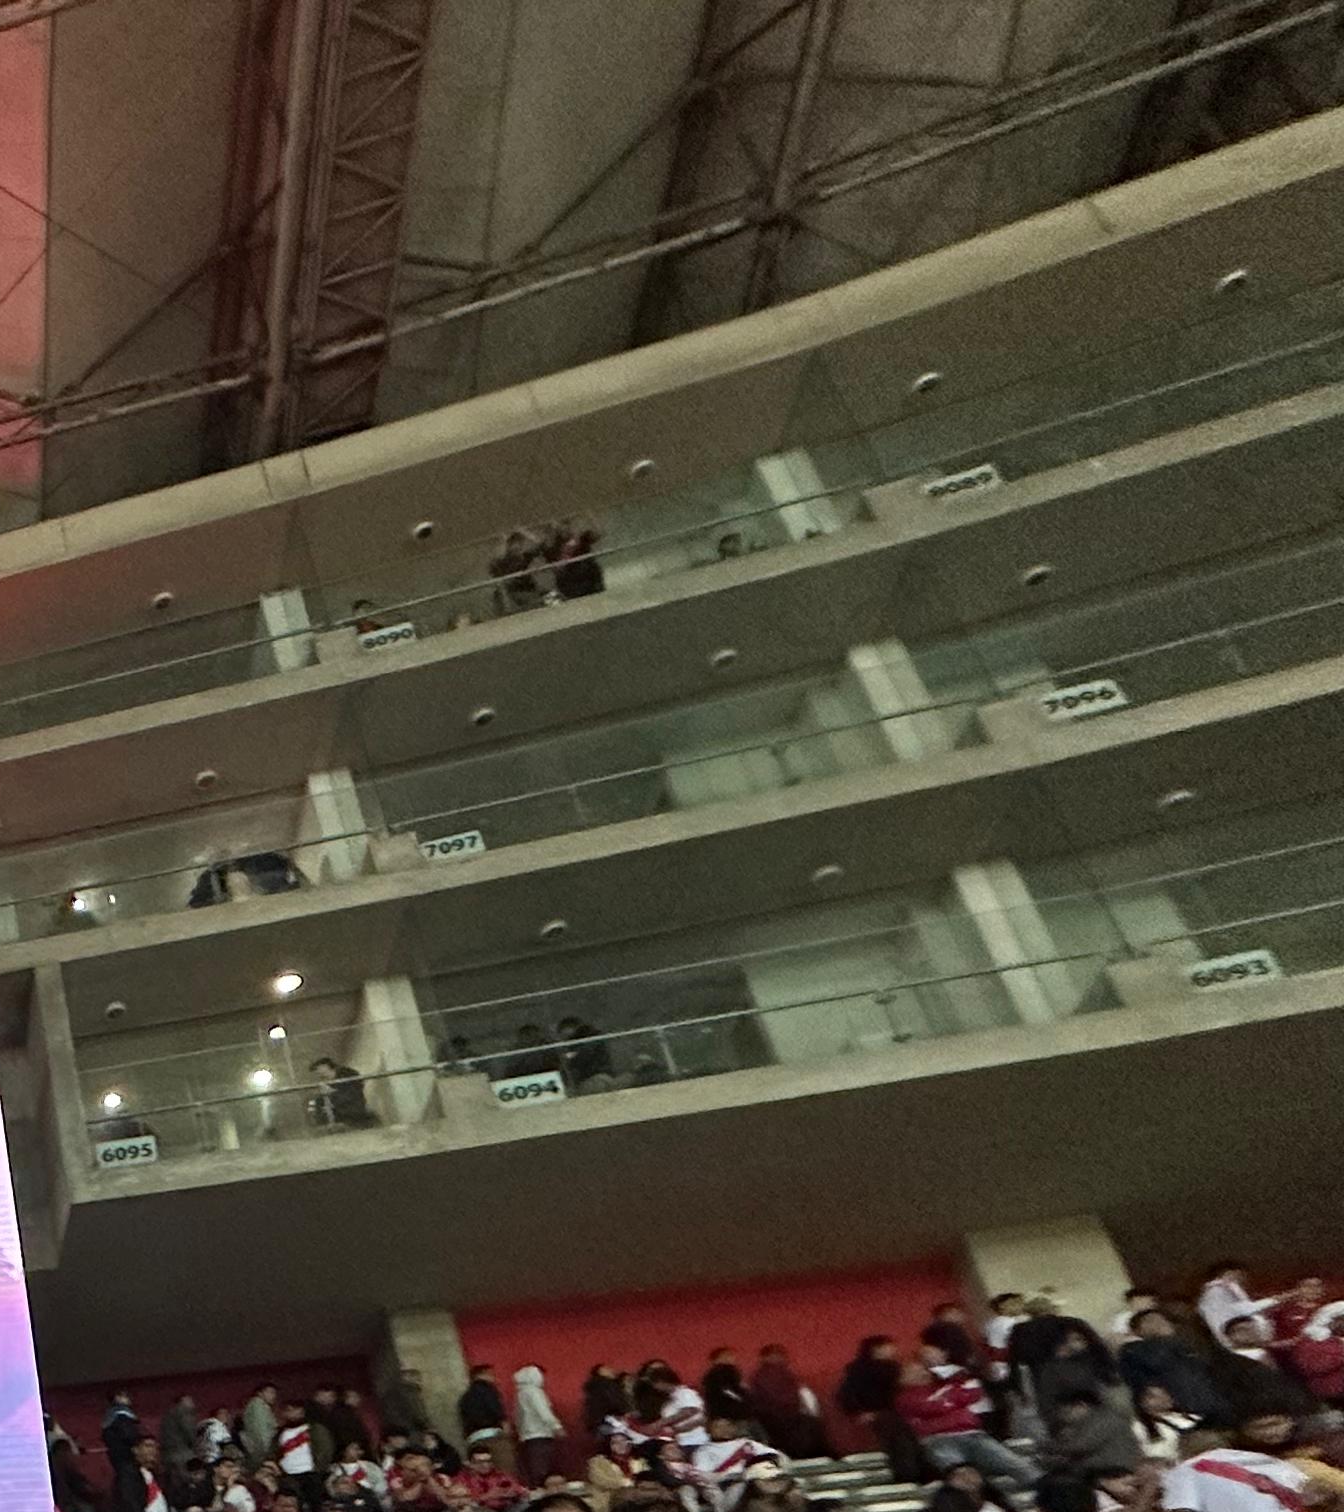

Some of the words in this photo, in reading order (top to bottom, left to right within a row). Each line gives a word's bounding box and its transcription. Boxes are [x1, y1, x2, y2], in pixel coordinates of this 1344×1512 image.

[424, 835, 478, 858] 7097
[498, 1079, 560, 1103] 6094
[102, 1143, 153, 1163] 6095
